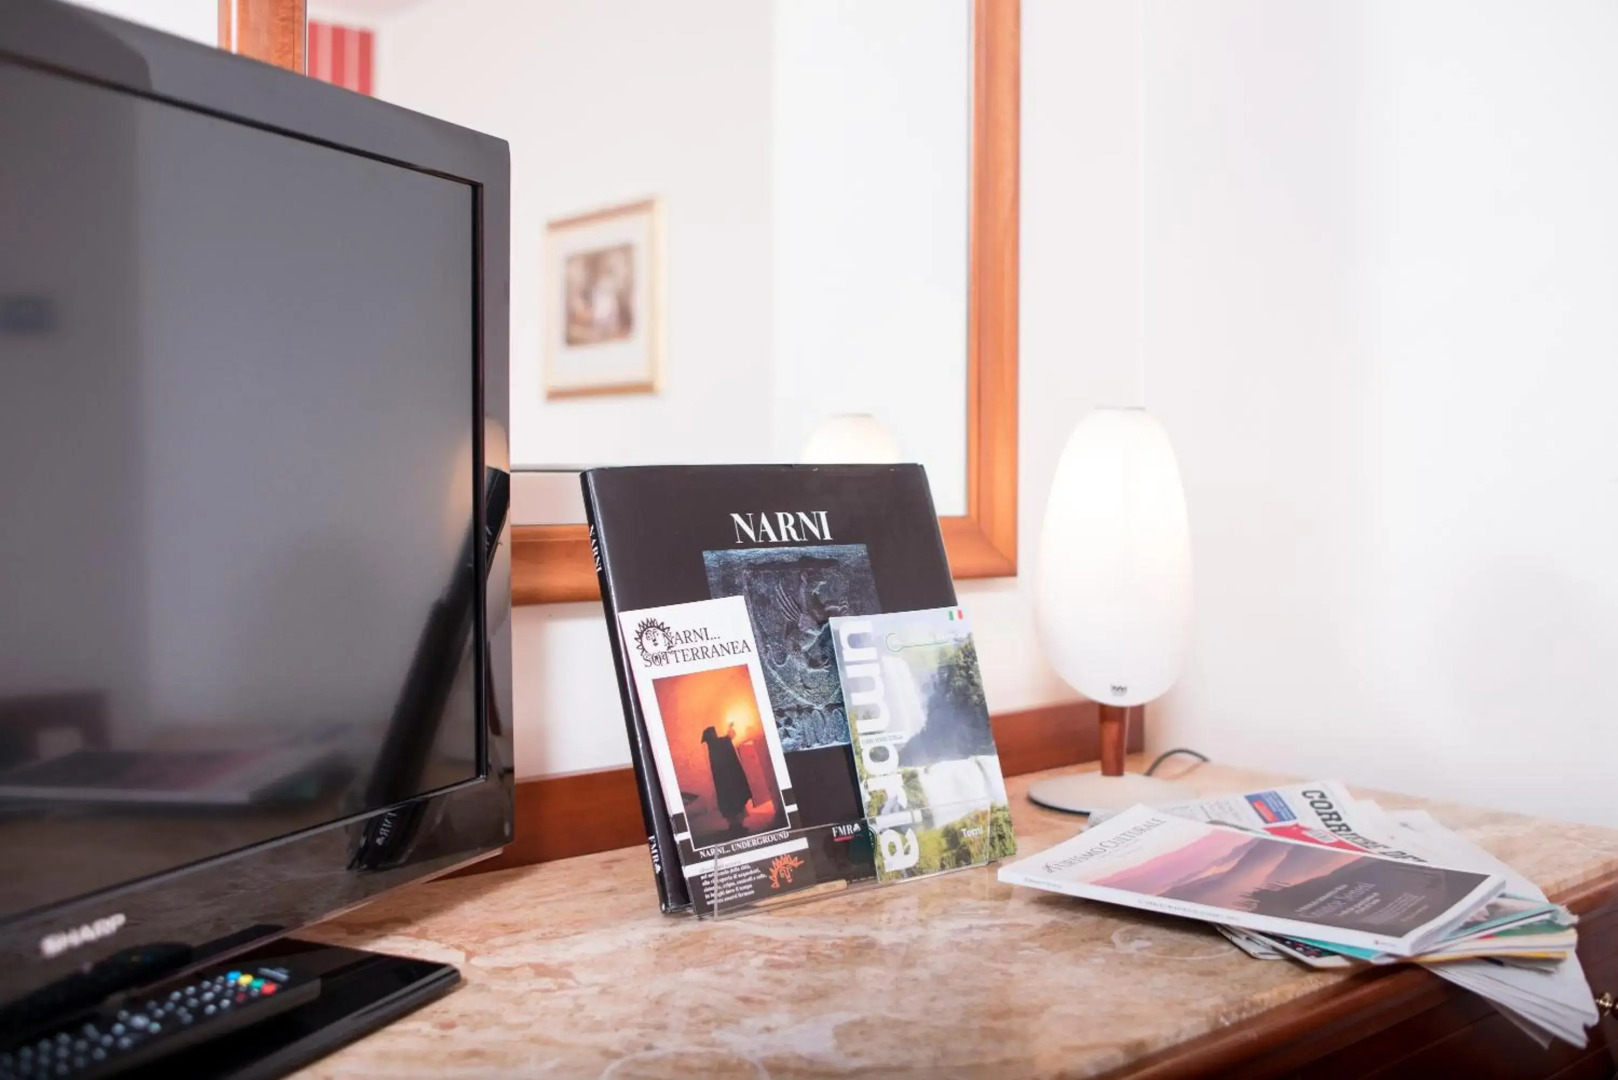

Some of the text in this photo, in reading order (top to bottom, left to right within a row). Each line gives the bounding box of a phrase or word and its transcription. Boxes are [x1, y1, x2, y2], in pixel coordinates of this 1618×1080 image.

[729, 510, 833, 544] NARNI
[642, 638, 752, 668] SOTTERRANEA
[839, 620, 922, 873] umbria
[730, 830, 790, 852] UNDERGROUND
[832, 824, 854, 838] FMR
[648, 835, 660, 863] FMR
[41, 912, 127, 957] SHARP
